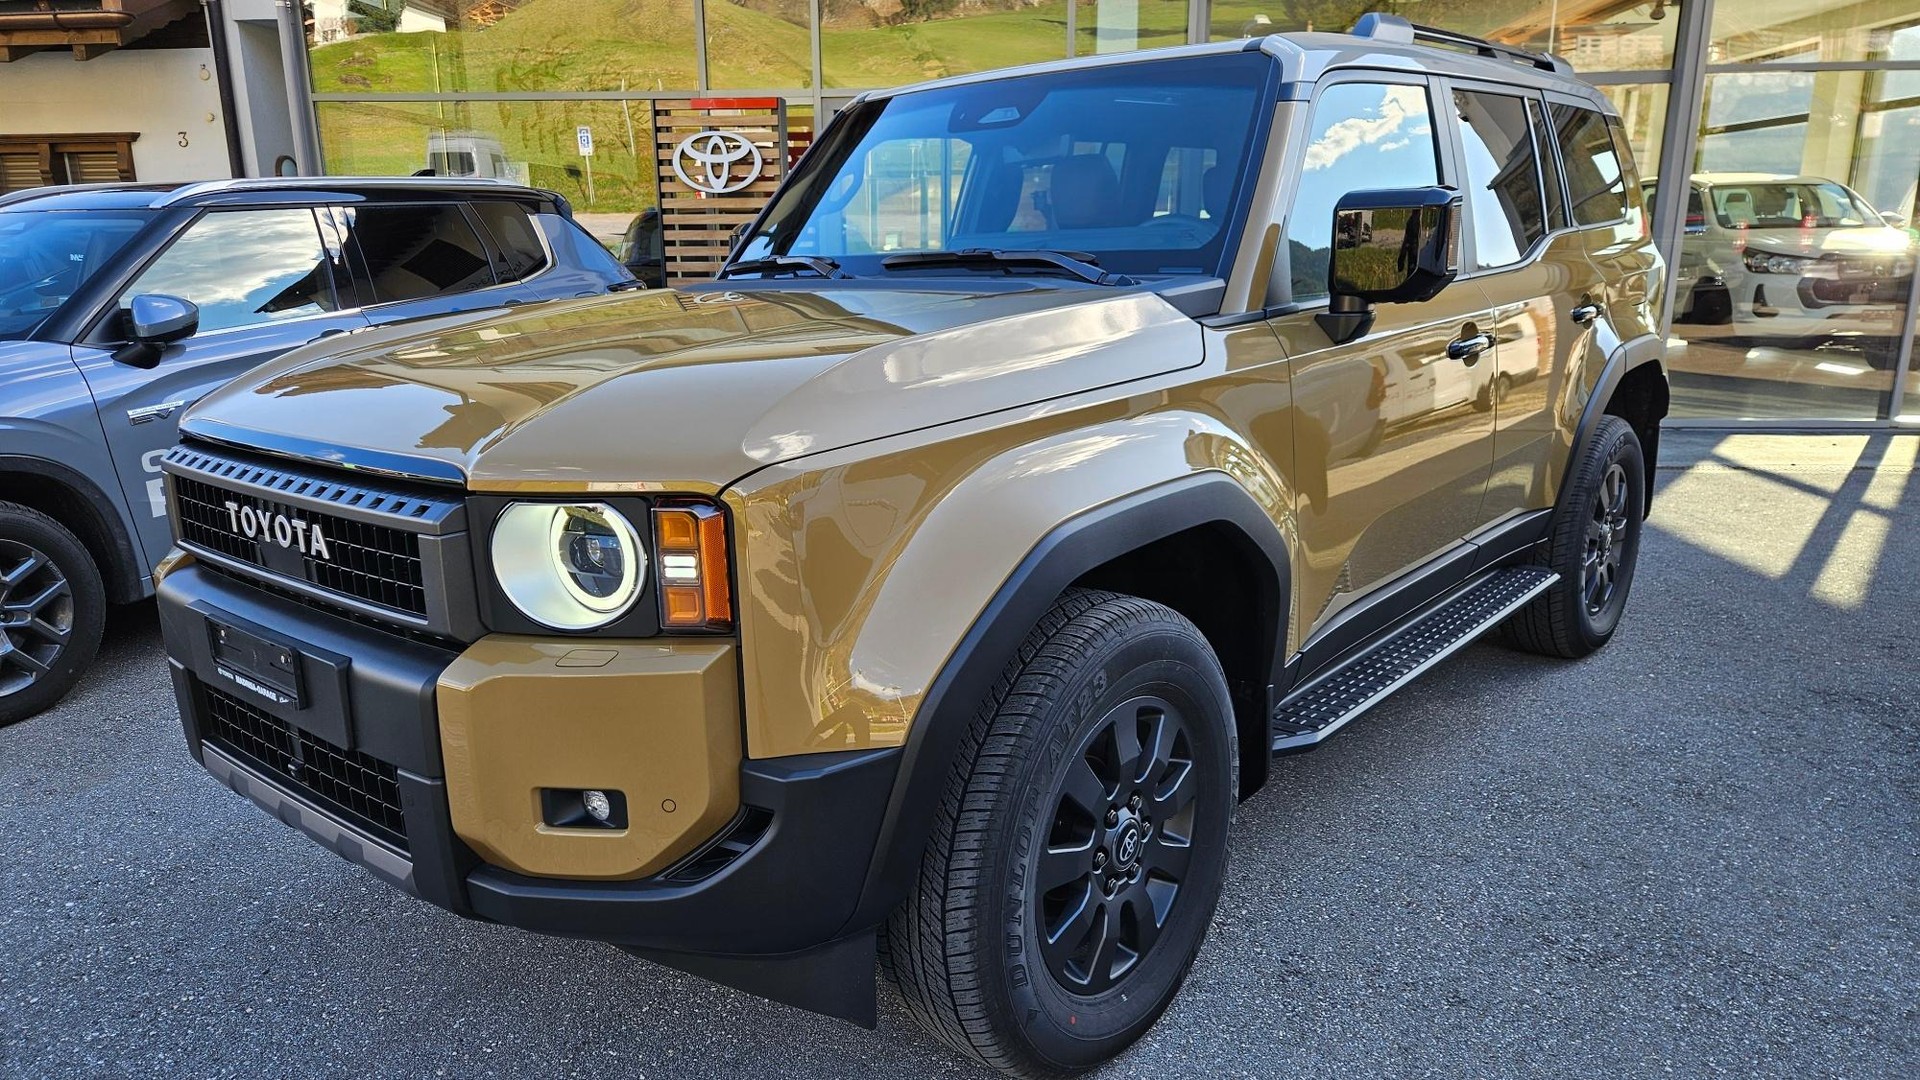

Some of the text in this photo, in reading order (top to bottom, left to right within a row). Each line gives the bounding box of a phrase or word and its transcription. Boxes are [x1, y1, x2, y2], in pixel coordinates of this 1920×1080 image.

[178, 131, 189, 148] 3
[225, 500, 330, 560] TOYOTA
[1007, 783, 1040, 989] DUNLOP
